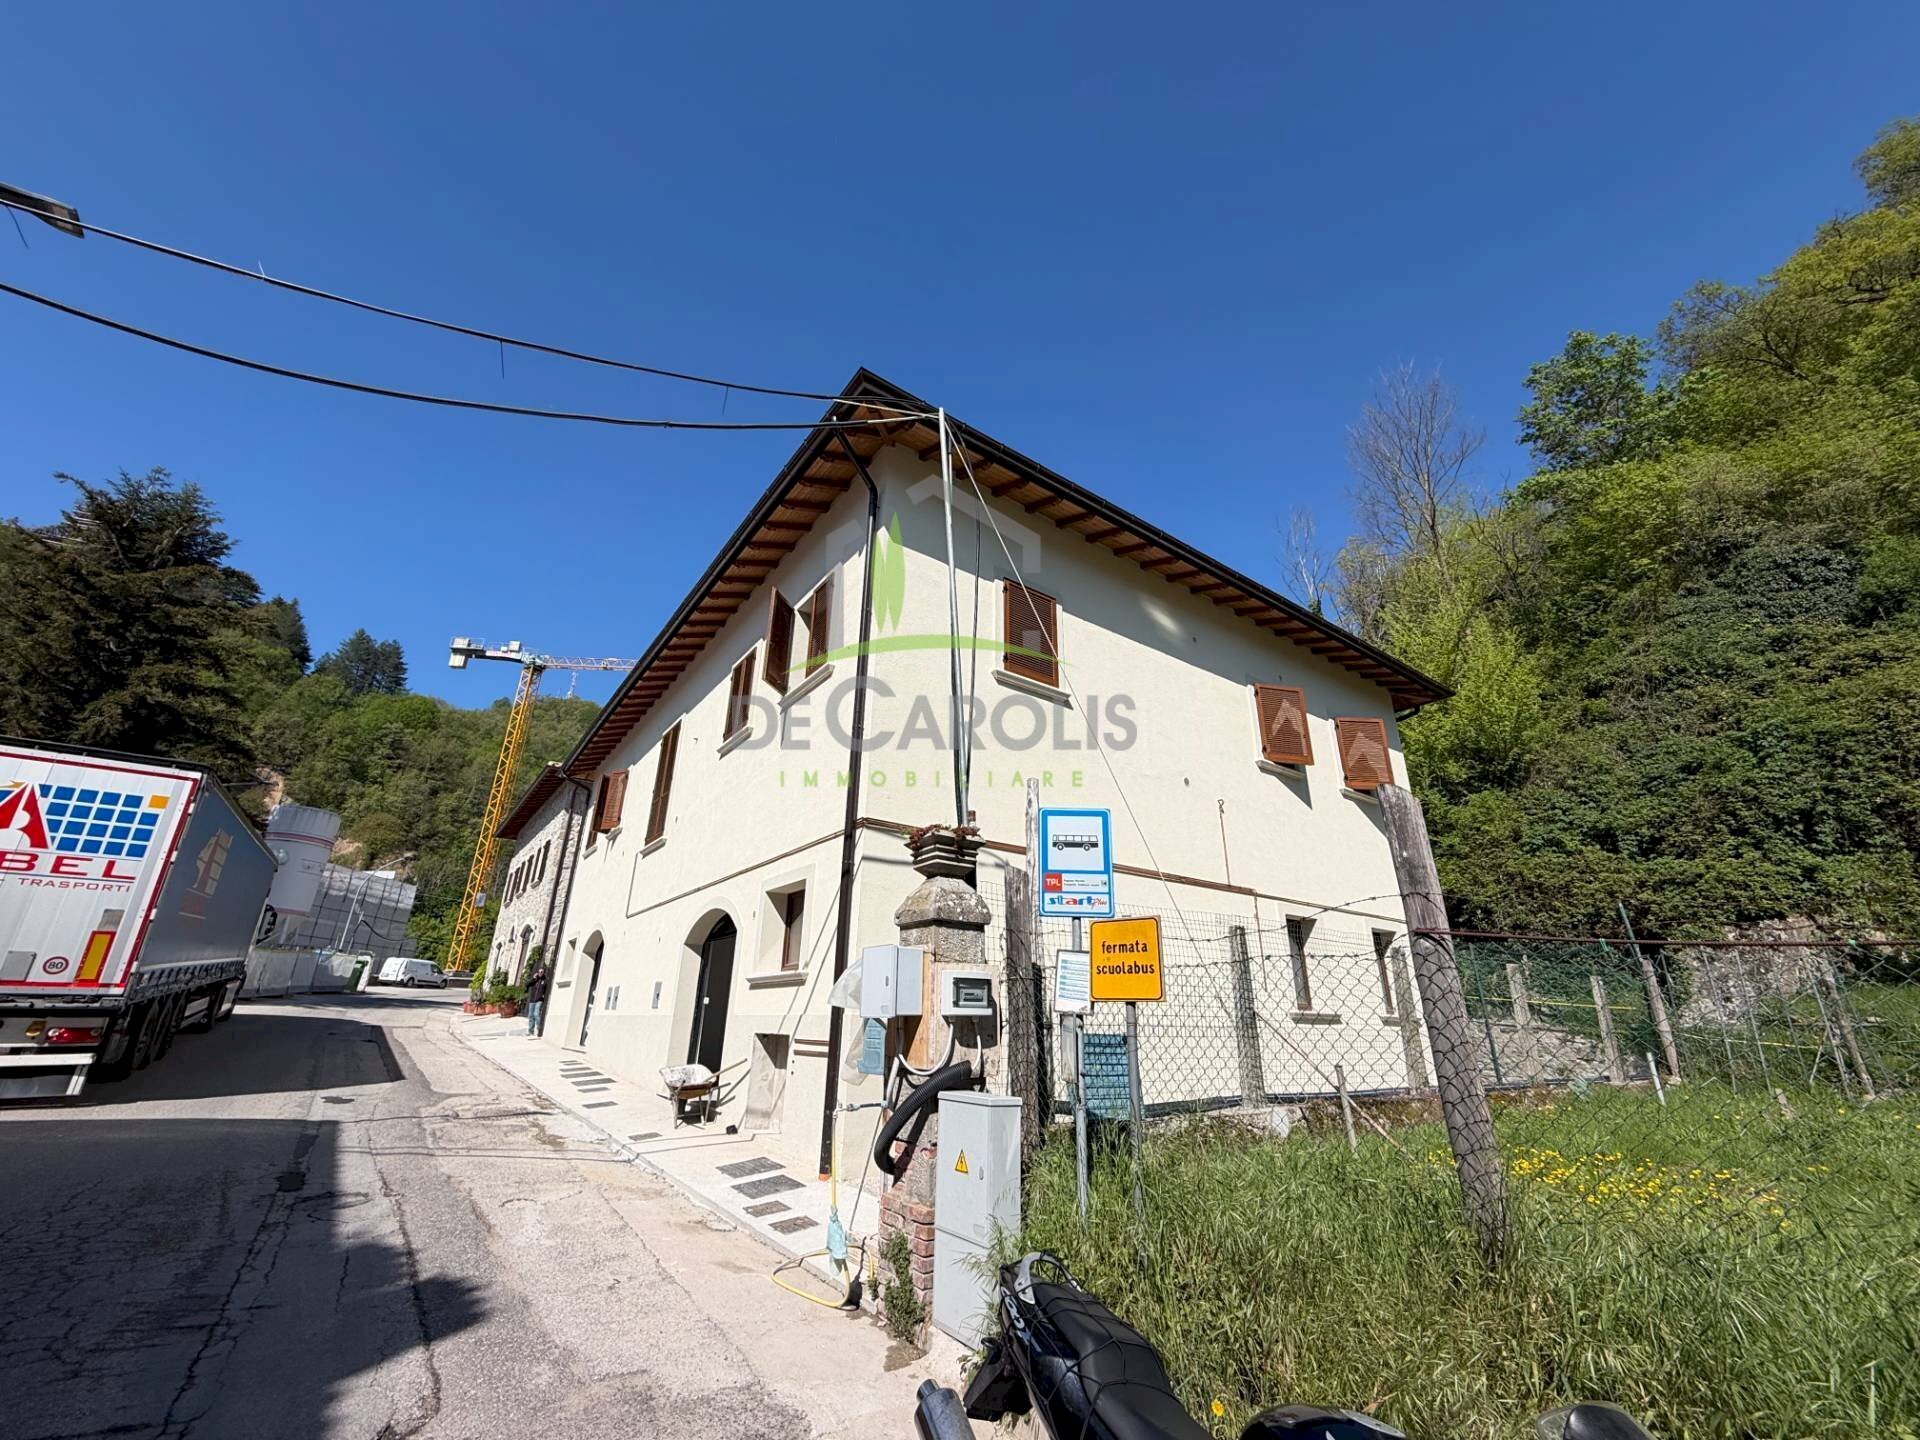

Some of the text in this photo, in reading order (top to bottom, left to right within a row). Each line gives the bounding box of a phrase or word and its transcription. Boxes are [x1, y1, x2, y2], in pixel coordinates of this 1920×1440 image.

[18, 878, 131, 892] TRASPORTI
[1045, 878, 1061, 887] TPL
[1101, 940, 1148, 954] fermata
[47, 961, 64, 970] 80
[1096, 961, 1155, 975] scuolabus
